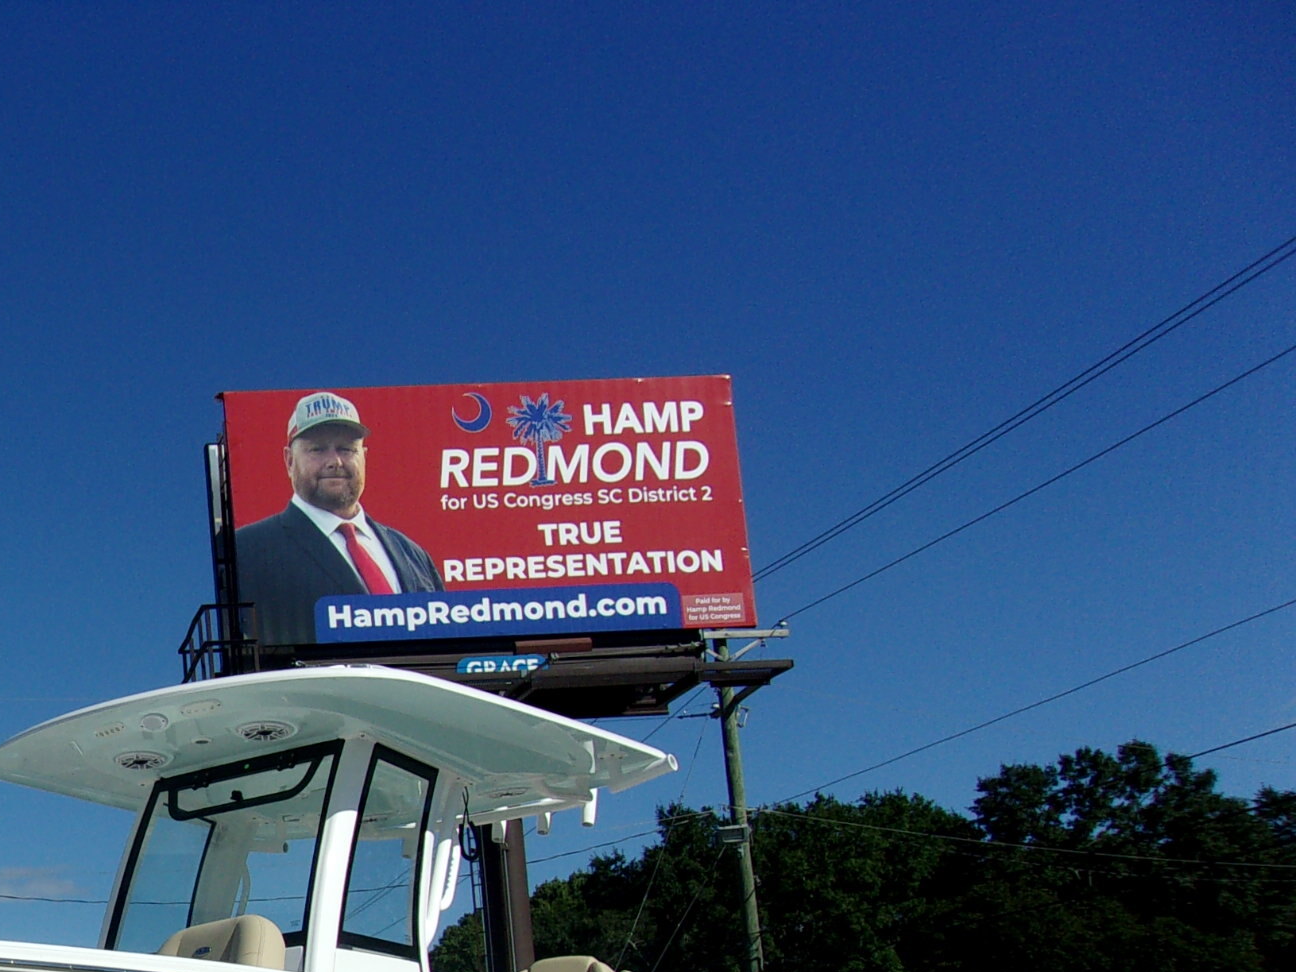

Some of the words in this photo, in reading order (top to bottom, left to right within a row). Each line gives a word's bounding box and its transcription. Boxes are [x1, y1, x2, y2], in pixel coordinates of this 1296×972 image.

[583, 400, 704, 436] HAMP
[440, 440, 710, 488] REDMOND
[440, 494, 468, 511] for
[473, 493, 499, 509] US
[503, 489, 593, 510] Congress
[597, 488, 623, 505] SC
[628, 486, 697, 504] District
[701, 485, 713, 502] 2
[537, 520, 623, 547] TRUE
[443, 549, 724, 583] REPRESENTATION
[327, 592, 668, 631] HampRedmond.com
[466, 658, 538, 674] GRACE
